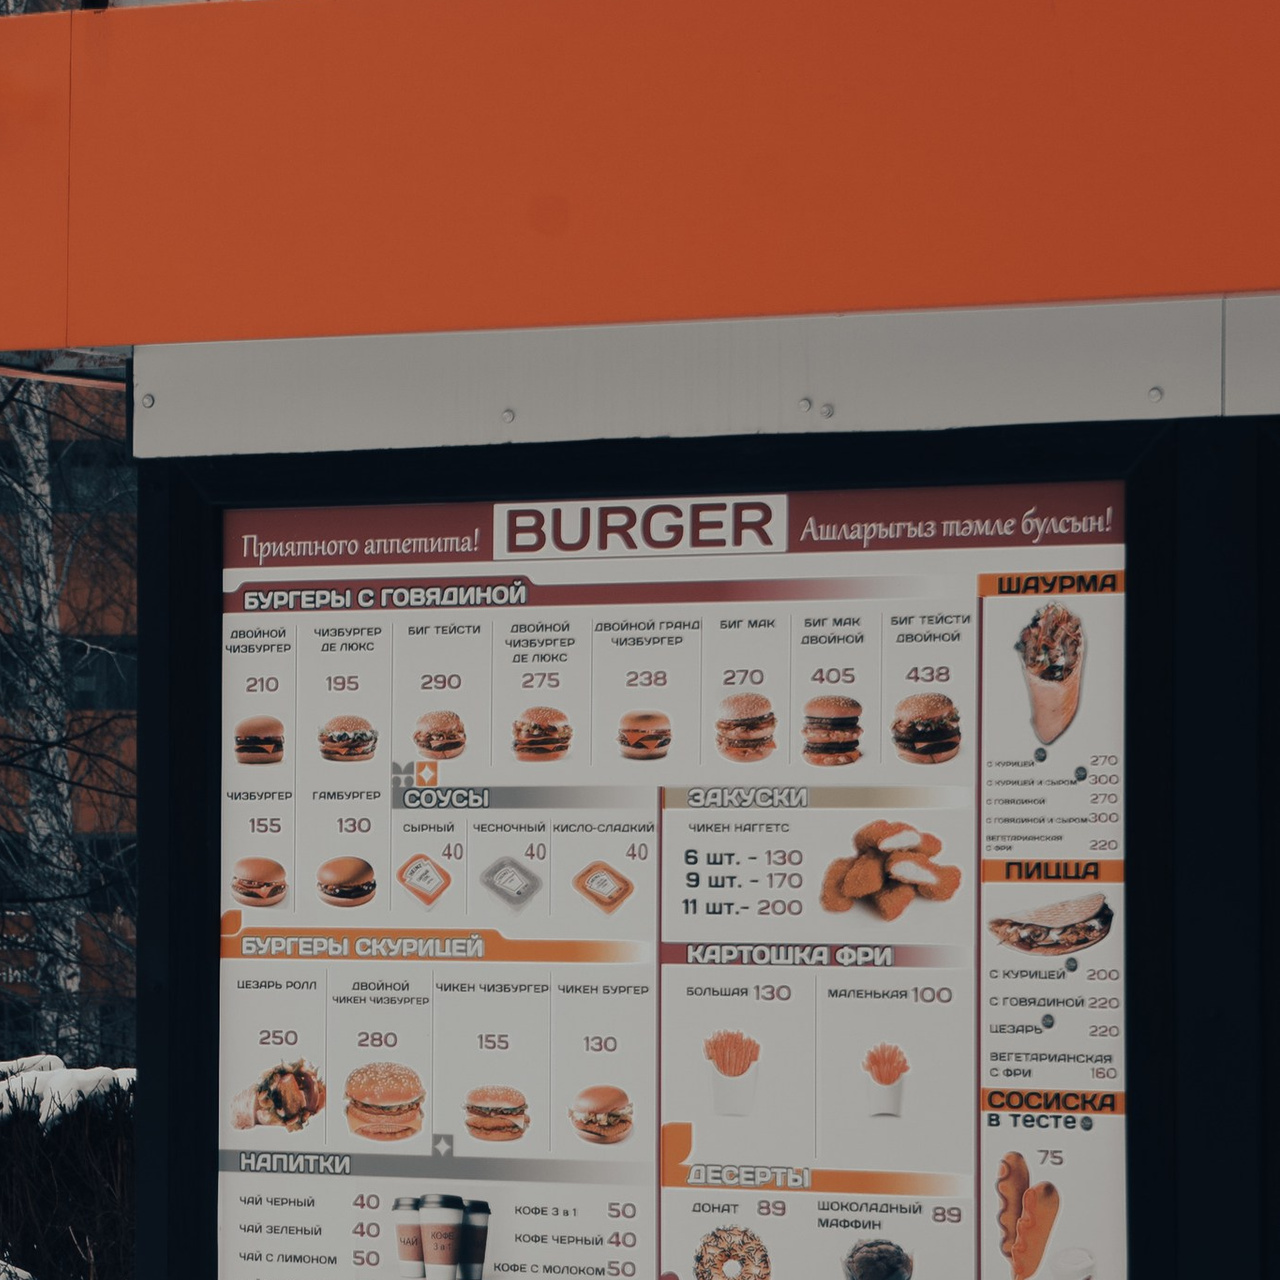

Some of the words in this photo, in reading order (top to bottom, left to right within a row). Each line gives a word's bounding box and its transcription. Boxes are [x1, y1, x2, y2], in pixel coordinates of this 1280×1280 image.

[506, 501, 774, 553] BURGER
[800, 516, 936, 548] Ашларыгыз
[942, 518, 1016, 537] тәмле
[1021, 506, 1112, 543] булсын!
[242, 535, 358, 565] Приятного
[365, 528, 479, 553] аппетита!
[997, 574, 1117, 594] ШАУРМА
[244, 590, 350, 611] БУРГЕРЫ
[358, 589, 374, 608] С
[381, 581, 526, 607] ГОВЯДИНОЙ
[510, 621, 570, 633] ДВОЙНОЙ
[594, 618, 655, 632] ДВОЙНОЙ
[659, 621, 700, 630] ГРАНД
[720, 620, 743, 630] БИГ
[748, 619, 775, 629] МАК
[804, 618, 828, 627] БИГ
[833, 617, 861, 627] МАК
[891, 615, 914, 626] БИГ
[921, 613, 971, 625] ТЕЙСТИ
[230, 627, 286, 639] ДВОЙНОЙ
[314, 627, 382, 637] ЧИЗБУРГЕР
[408, 626, 431, 636] БИГ
[435, 624, 480, 634] ТЕЙСТИ
[896, 630, 961, 642] ДВОЙНОЙ
[505, 638, 575, 648] ЧИЗБУРГЕР
[611, 636, 682, 647] ЧИЗБУРГЕР
[801, 632, 864, 644] ДВОЙНОЙ
[225, 643, 291, 654] ЧИЗБУРГЕР
[321, 642, 336, 652] ДЕ
[341, 642, 374, 652] ЛЮКС
[512, 654, 528, 663] ДЕ
[533, 653, 567, 662] ЛЮКС
[522, 672, 559, 688] 275
[626, 671, 667, 687] 238
[722, 669, 764, 685] 270
[811, 668, 855, 684] 405
[905, 666, 950, 682] 438
[245, 677, 278, 692] 210
[326, 675, 359, 691] 195
[420, 674, 461, 690] 290
[1090, 755, 1118, 765] 270
[1089, 774, 1119, 785] 300
[227, 792, 292, 801] ЧИЗБУРГЕР
[312, 790, 381, 800] ГАМБУРГЕР
[404, 789, 490, 808] СОУСЫ
[687, 788, 808, 808] ЗАКУСКИ
[1090, 793, 1118, 804] 270
[249, 818, 281, 833] 155
[337, 818, 371, 833] 130
[1088, 813, 1119, 823] 300
[403, 822, 455, 833] СЫРНЫЙ
[473, 822, 545, 833] ЧЕСНОЧНЫЙ
[553, 822, 655, 834] КИСЛО-СЛАДКИЙ
[689, 823, 730, 833] ЧИКЕН
[735, 823, 790, 833] НАГГЕТС
[442, 843, 463, 860] 40
[525, 843, 546, 860] 40
[626, 843, 648, 860] 40
[1089, 840, 1118, 850] 220
[684, 849, 698, 865] 6
[707, 851, 740, 865] шт.
[765, 850, 803, 865] 130
[1005, 862, 1099, 879] ПИЦЦА
[686, 873, 699, 889] 9
[709, 874, 742, 888] шт.
[767, 873, 803, 888] 170
[682, 899, 697, 914] 11
[757, 900, 803, 915] 200
[241, 936, 348, 956] БУРГЕРЫ
[687, 945, 828, 965] КАРТОШКА
[836, 945, 893, 966] ФРИ
[1003, 967, 1065, 979] КУРИЦЕЙ
[1087, 969, 1120, 981] 200
[237, 980, 282, 991] ЦЕЗАРЬ
[286, 980, 317, 991] РОЛЛ
[352, 979, 409, 992] ДВОЙНОЙ
[435, 983, 475, 993] ЧИКЕН
[479, 983, 549, 994] ЧИЗБУРГЕР
[558, 984, 599, 994] ЧИКЕН
[602, 985, 649, 995] БУРГЕР
[687, 987, 748, 997] БОЛЬШАЯ
[754, 985, 791, 1000] 130
[332, 996, 367, 1005] ЧИКЕН
[369, 996, 429, 1006] ЧИЗБУРГЕР
[828, 989, 907, 999] МАЛЕНЬКАЯ
[912, 987, 952, 1003] 100
[1003, 995, 1084, 1007] ГОВЯДИНОЙ
[1088, 997, 1120, 1009] 220
[259, 1030, 298, 1046] 250
[990, 1024, 1043, 1035] ЦЕЗАРЬ
[1089, 1026, 1120, 1037] 220
[357, 1032, 398, 1048] 280
[477, 1034, 509, 1050] 155
[583, 1037, 618, 1053] 130
[990, 1052, 1112, 1063] ВЕГЕТАРИАНСКАЯ
[1003, 1068, 1031, 1077] ФРИ
[1091, 1068, 1117, 1079] 160
[987, 1091, 1115, 1111] СОСИСКА
[987, 1114, 1000, 1126] в
[1009, 1114, 1076, 1129] тесте
[239, 1152, 351, 1175] НАПИТКИ
[1037, 1150, 1064, 1165] 75
[688, 1165, 810, 1189] ДЕСЕРТЫ
[239, 1194, 263, 1205] ЧАЙ
[266, 1196, 315, 1207] ЧЕРНЫЙ
[352, 1194, 380, 1210] 40
[691, 1204, 739, 1214] ДОНАТ
[757, 1200, 786, 1217] 89
[515, 1206, 548, 1216] КОФЕ
[552, 1207, 559, 1216] 3
[608, 1203, 636, 1219] 50
[817, 1200, 922, 1215] ШОКОЛАДНЫЙ
[932, 1207, 962, 1223] 89
[239, 1223, 262, 1233] ЧАЙ
[266, 1224, 322, 1236] ЗЕЛЕНЫЙ
[352, 1222, 380, 1238] 40
[817, 1218, 882, 1230] МАФФИН
[515, 1233, 548, 1244] КОФЕ
[552, 1233, 603, 1246] ЧЕРНЫЙ
[607, 1232, 636, 1248] 40
[239, 1251, 262, 1262] ЧАЙ
[277, 1253, 337, 1265] ЛИМОНОМ
[352, 1251, 380, 1267] 50
[494, 1263, 527, 1273] КОФЕ
[542, 1265, 605, 1276] МОЛОКОМ
[607, 1262, 636, 1278] 50
